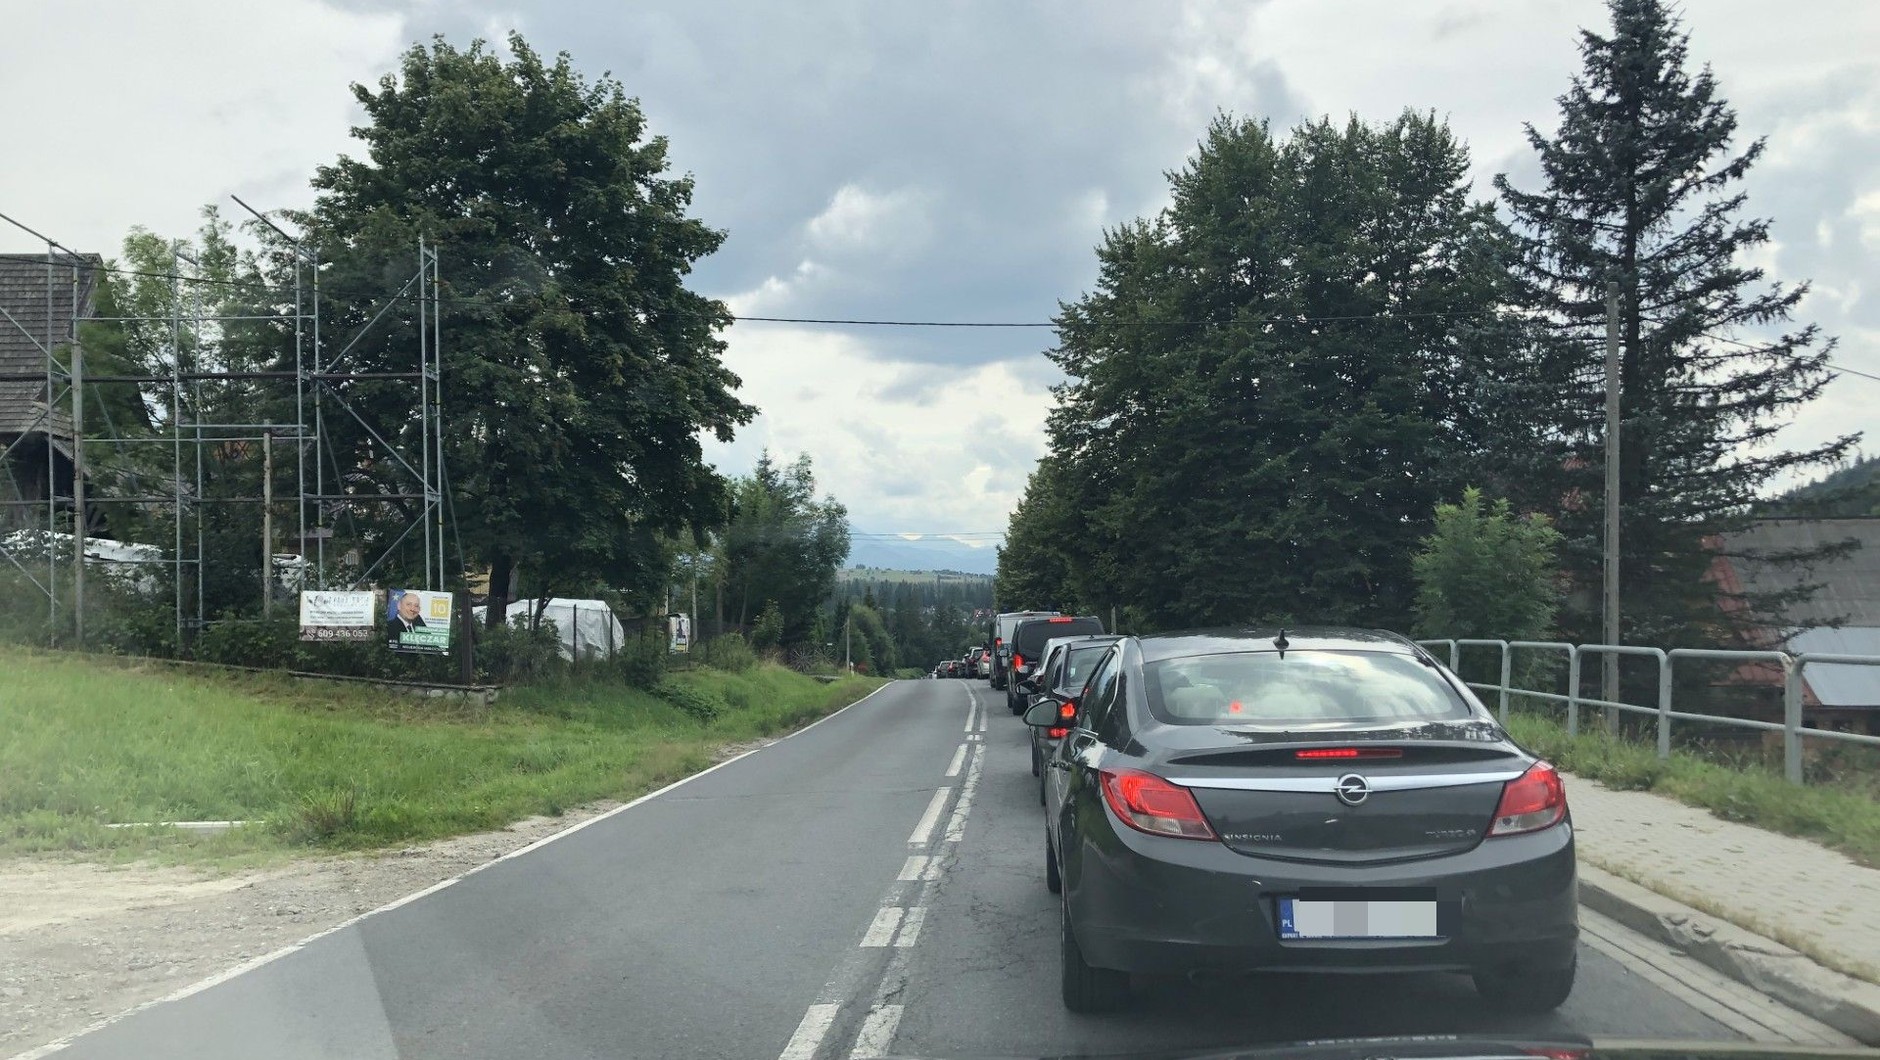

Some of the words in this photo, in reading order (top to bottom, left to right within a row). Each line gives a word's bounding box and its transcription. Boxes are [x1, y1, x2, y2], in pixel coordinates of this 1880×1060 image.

[432, 602, 446, 615] 10
[317, 629, 334, 638] 609
[335, 629, 351, 638] 436
[1229, 833, 1282, 841] INSIGNIA
[1282, 919, 1292, 928] PL
